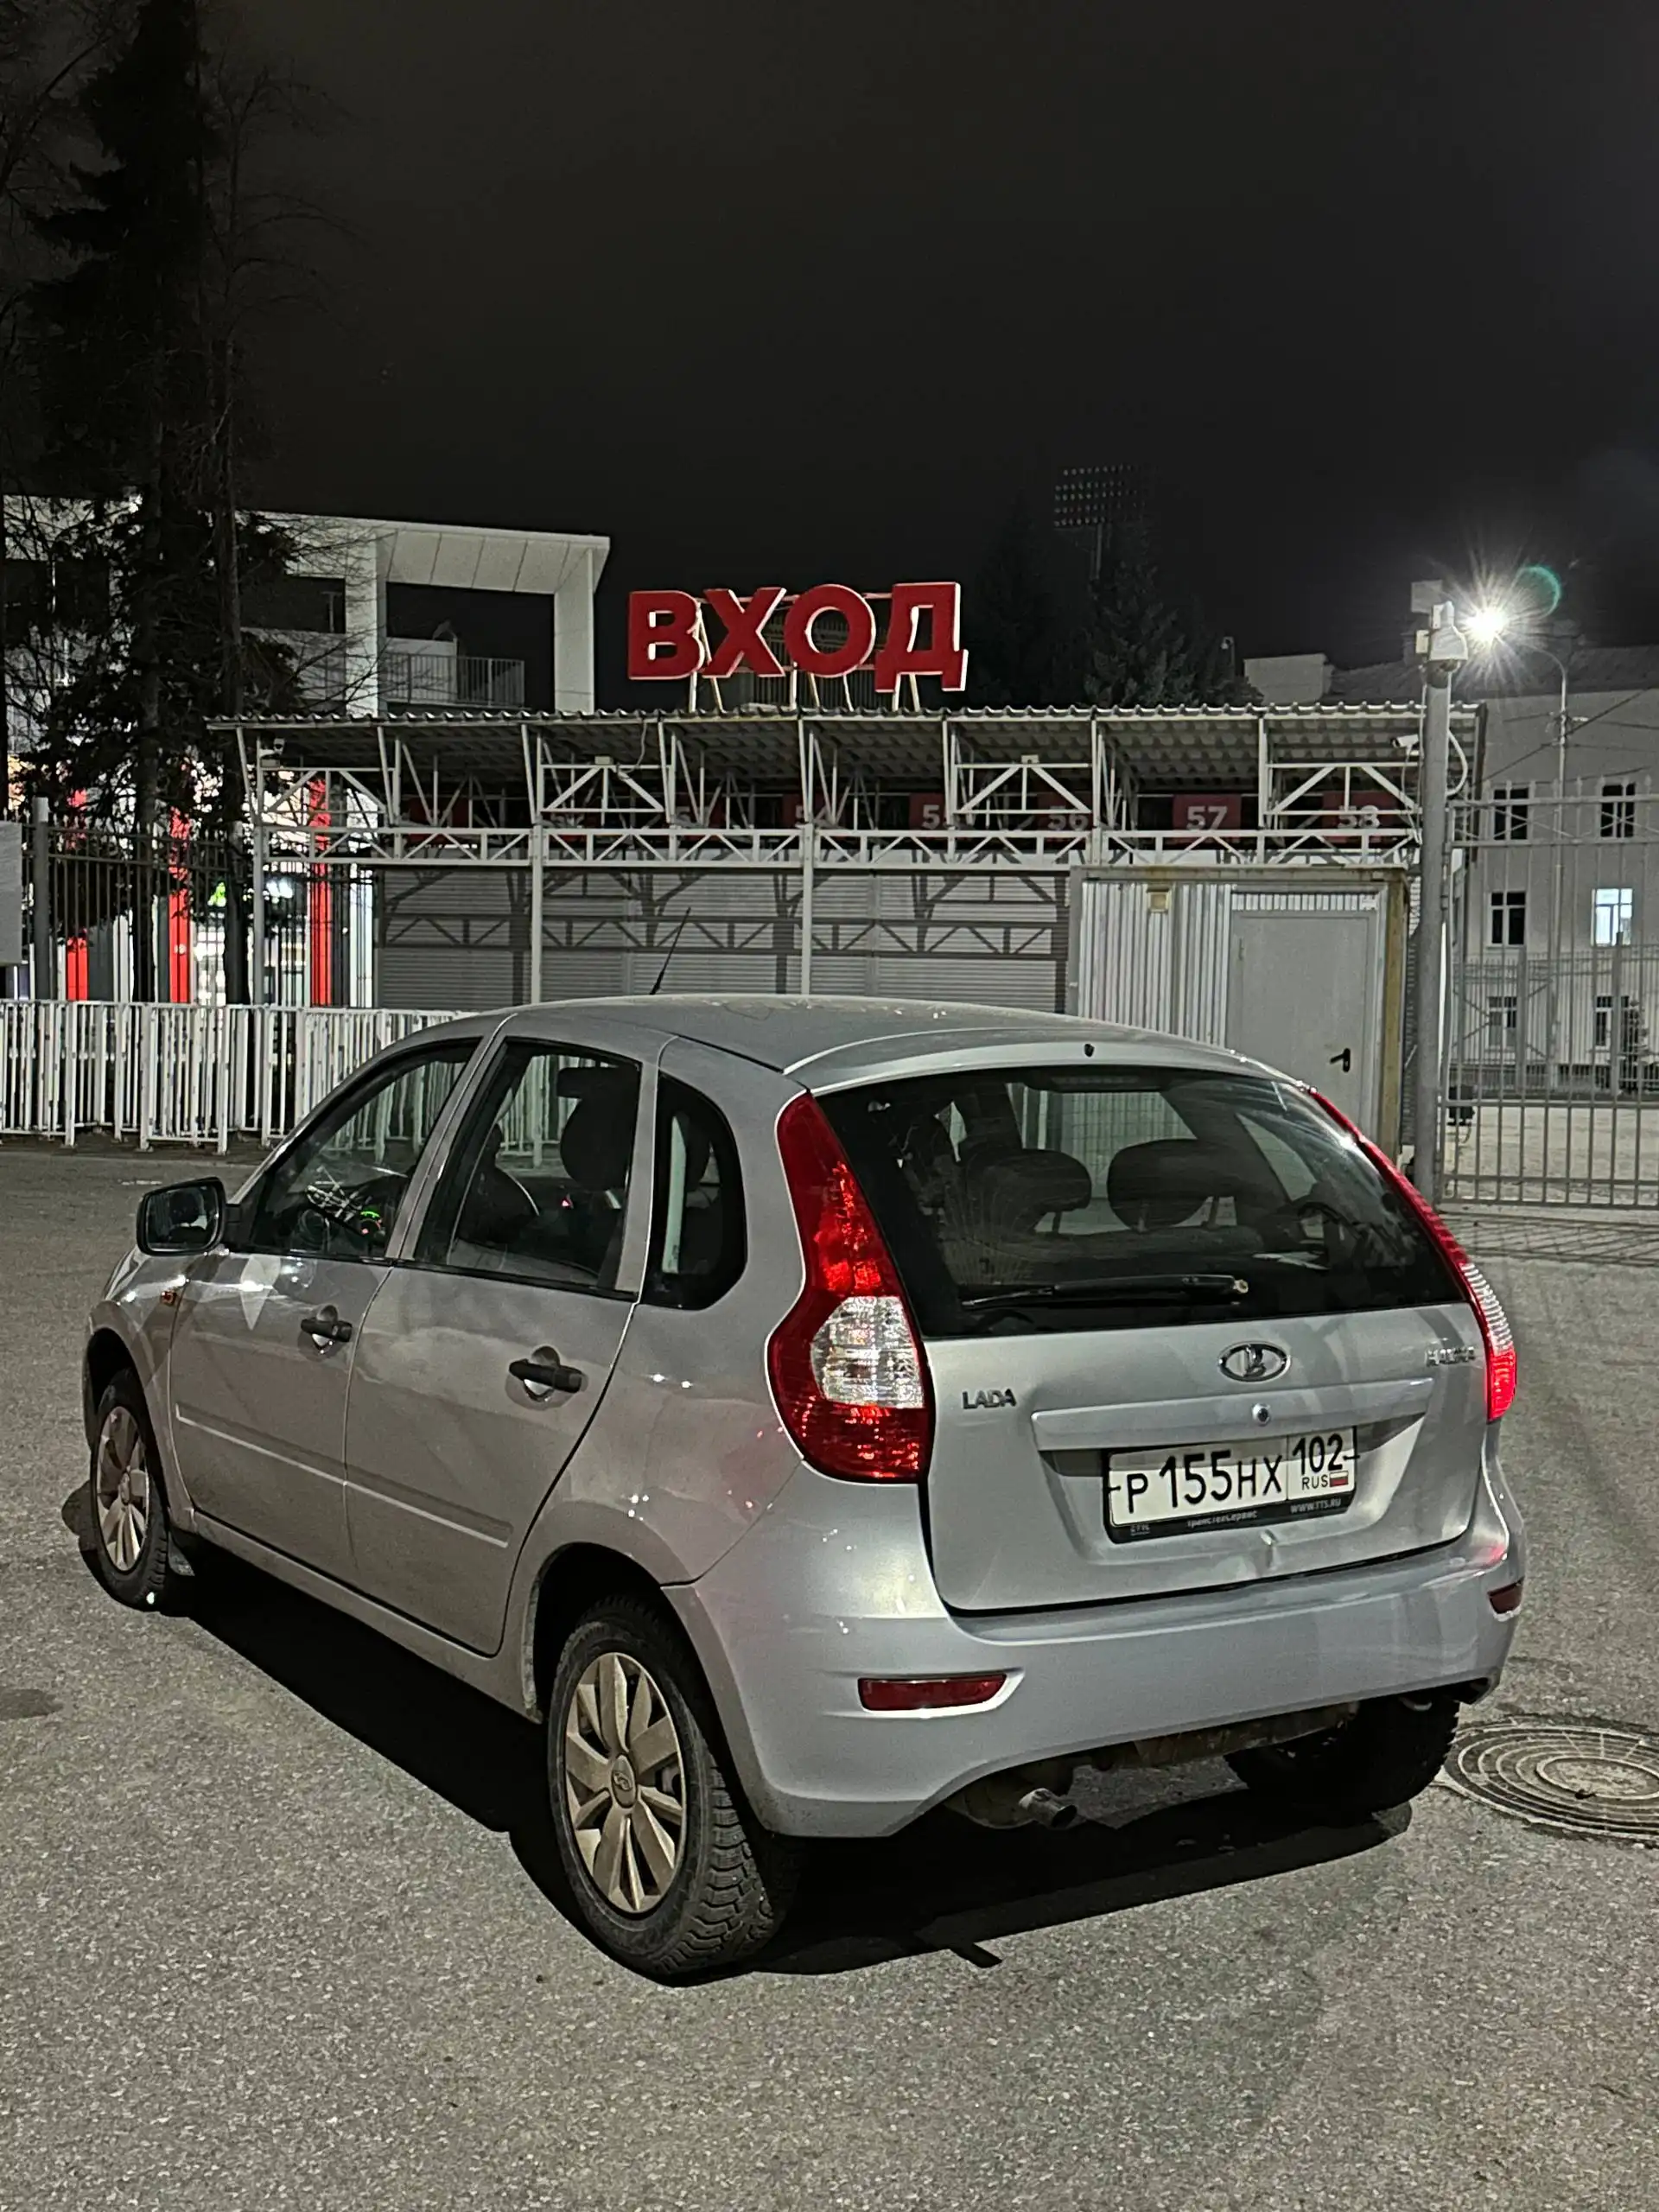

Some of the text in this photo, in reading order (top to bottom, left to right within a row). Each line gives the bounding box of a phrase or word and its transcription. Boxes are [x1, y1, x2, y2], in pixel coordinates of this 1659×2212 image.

[628, 582, 969, 693] ВХОД
[1047, 805, 1089, 830] 56
[1186, 805, 1228, 830] 57
[1338, 804, 1381, 830] 58
[962, 1388, 1017, 1410] LADA
[1293, 1433, 1344, 1476] 102
[1301, 1473, 1329, 1491] RUS
